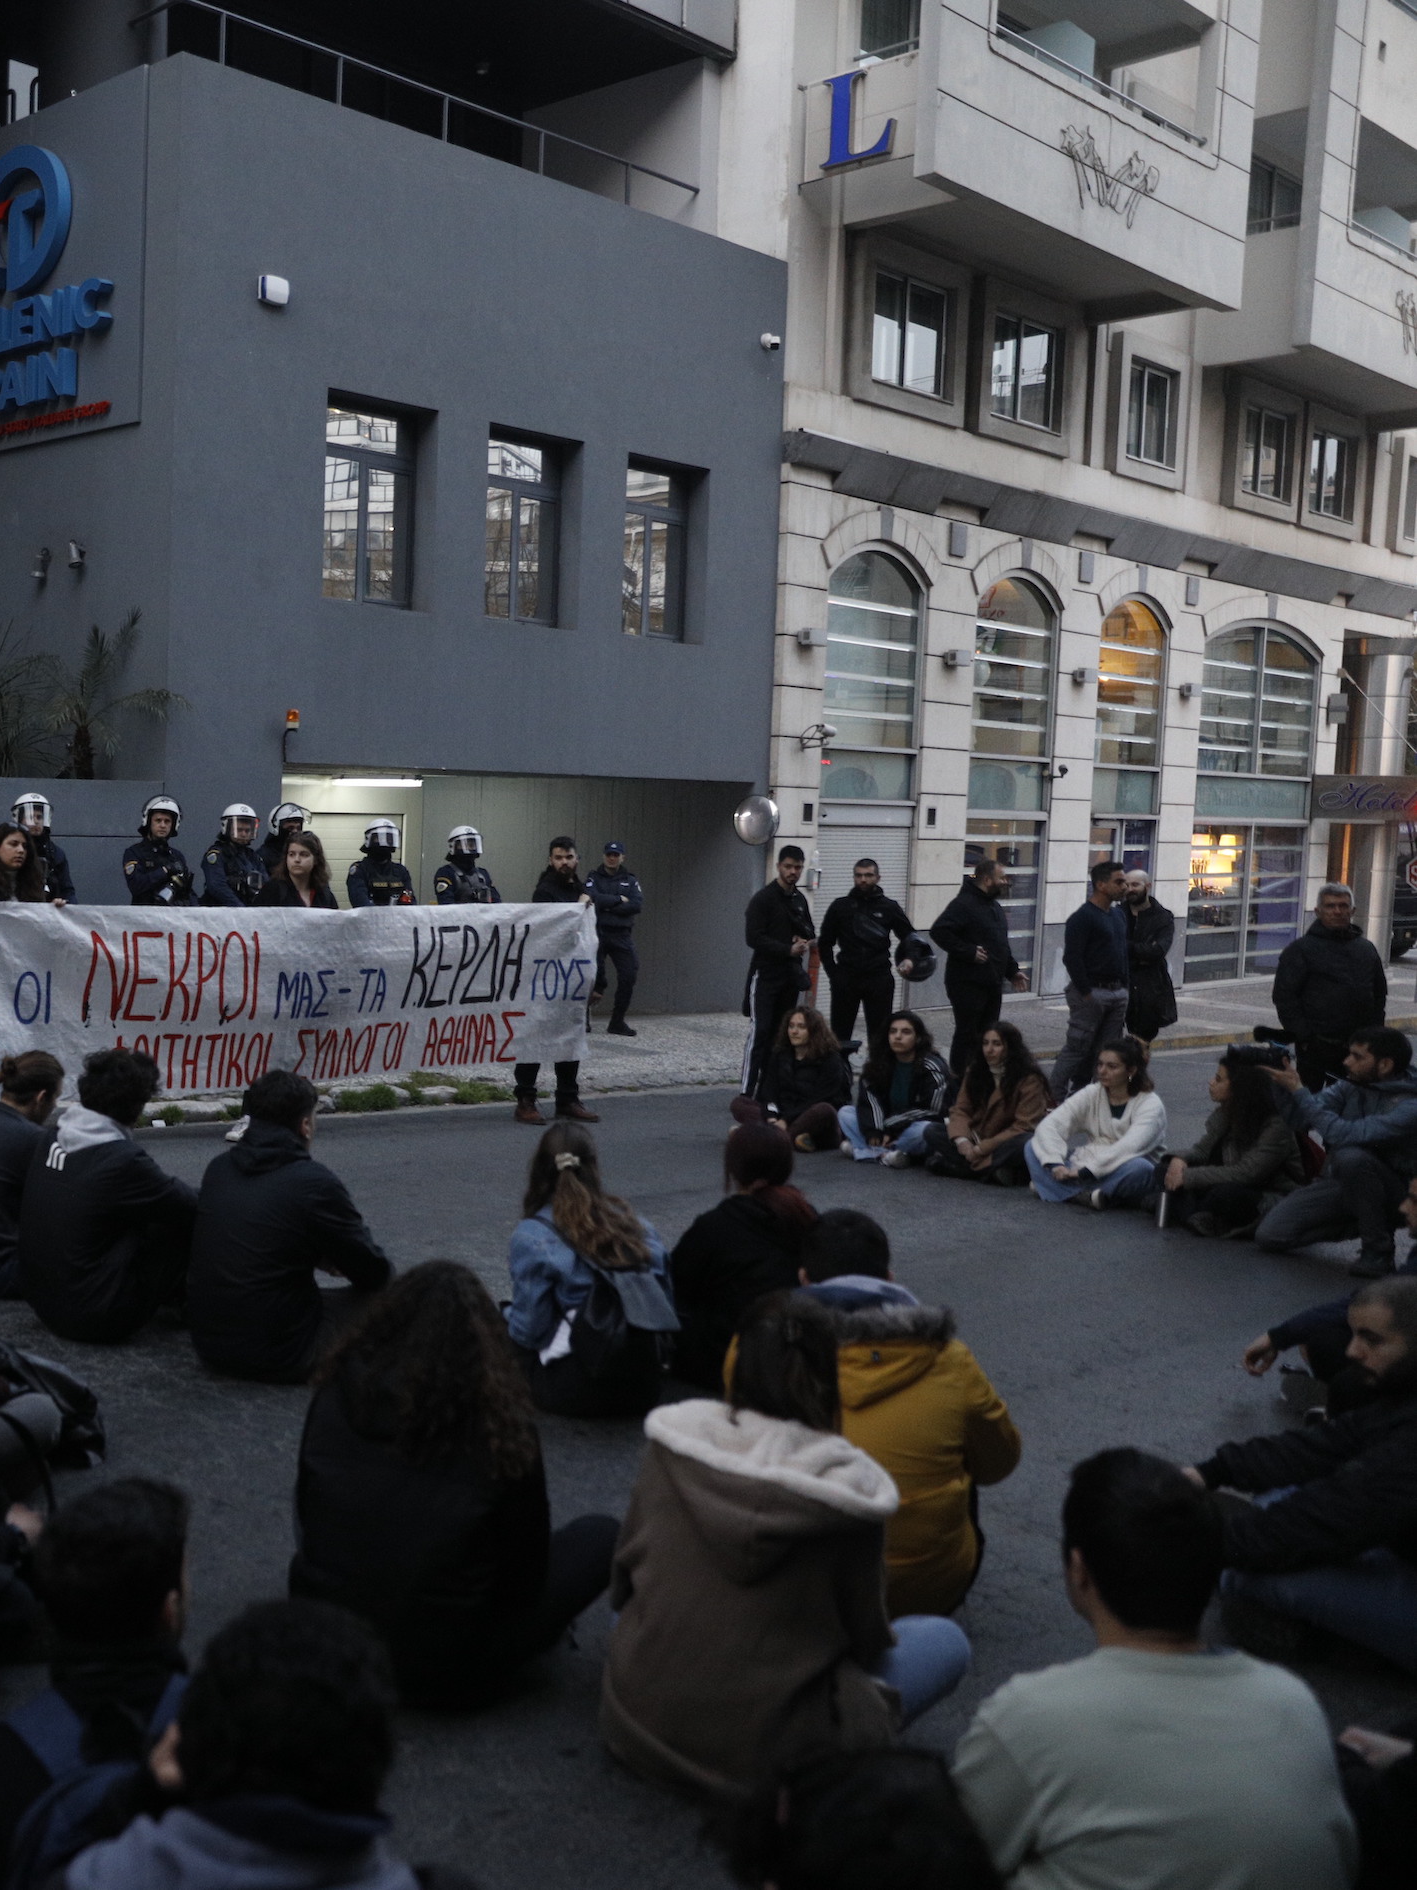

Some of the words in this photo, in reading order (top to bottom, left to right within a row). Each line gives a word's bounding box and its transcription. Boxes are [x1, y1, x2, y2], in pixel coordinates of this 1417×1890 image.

[820, 70, 896, 170] L
[14, 970, 51, 1024] ΟΙ
[82, 930, 260, 1024] ΝΕΚΡΟΙ
[400, 924, 530, 1009] ΚΕΡΔΗ
[532, 959, 591, 1001] ΤΟΥΣ
[112, 1033, 273, 1089] ΙΤΗΤΙΚΟΙ
[293, 1022, 409, 1080] ΣΥΛΛΟΓΟΙ
[421, 1011, 526, 1067] ΑΘΗΝΑΣ
